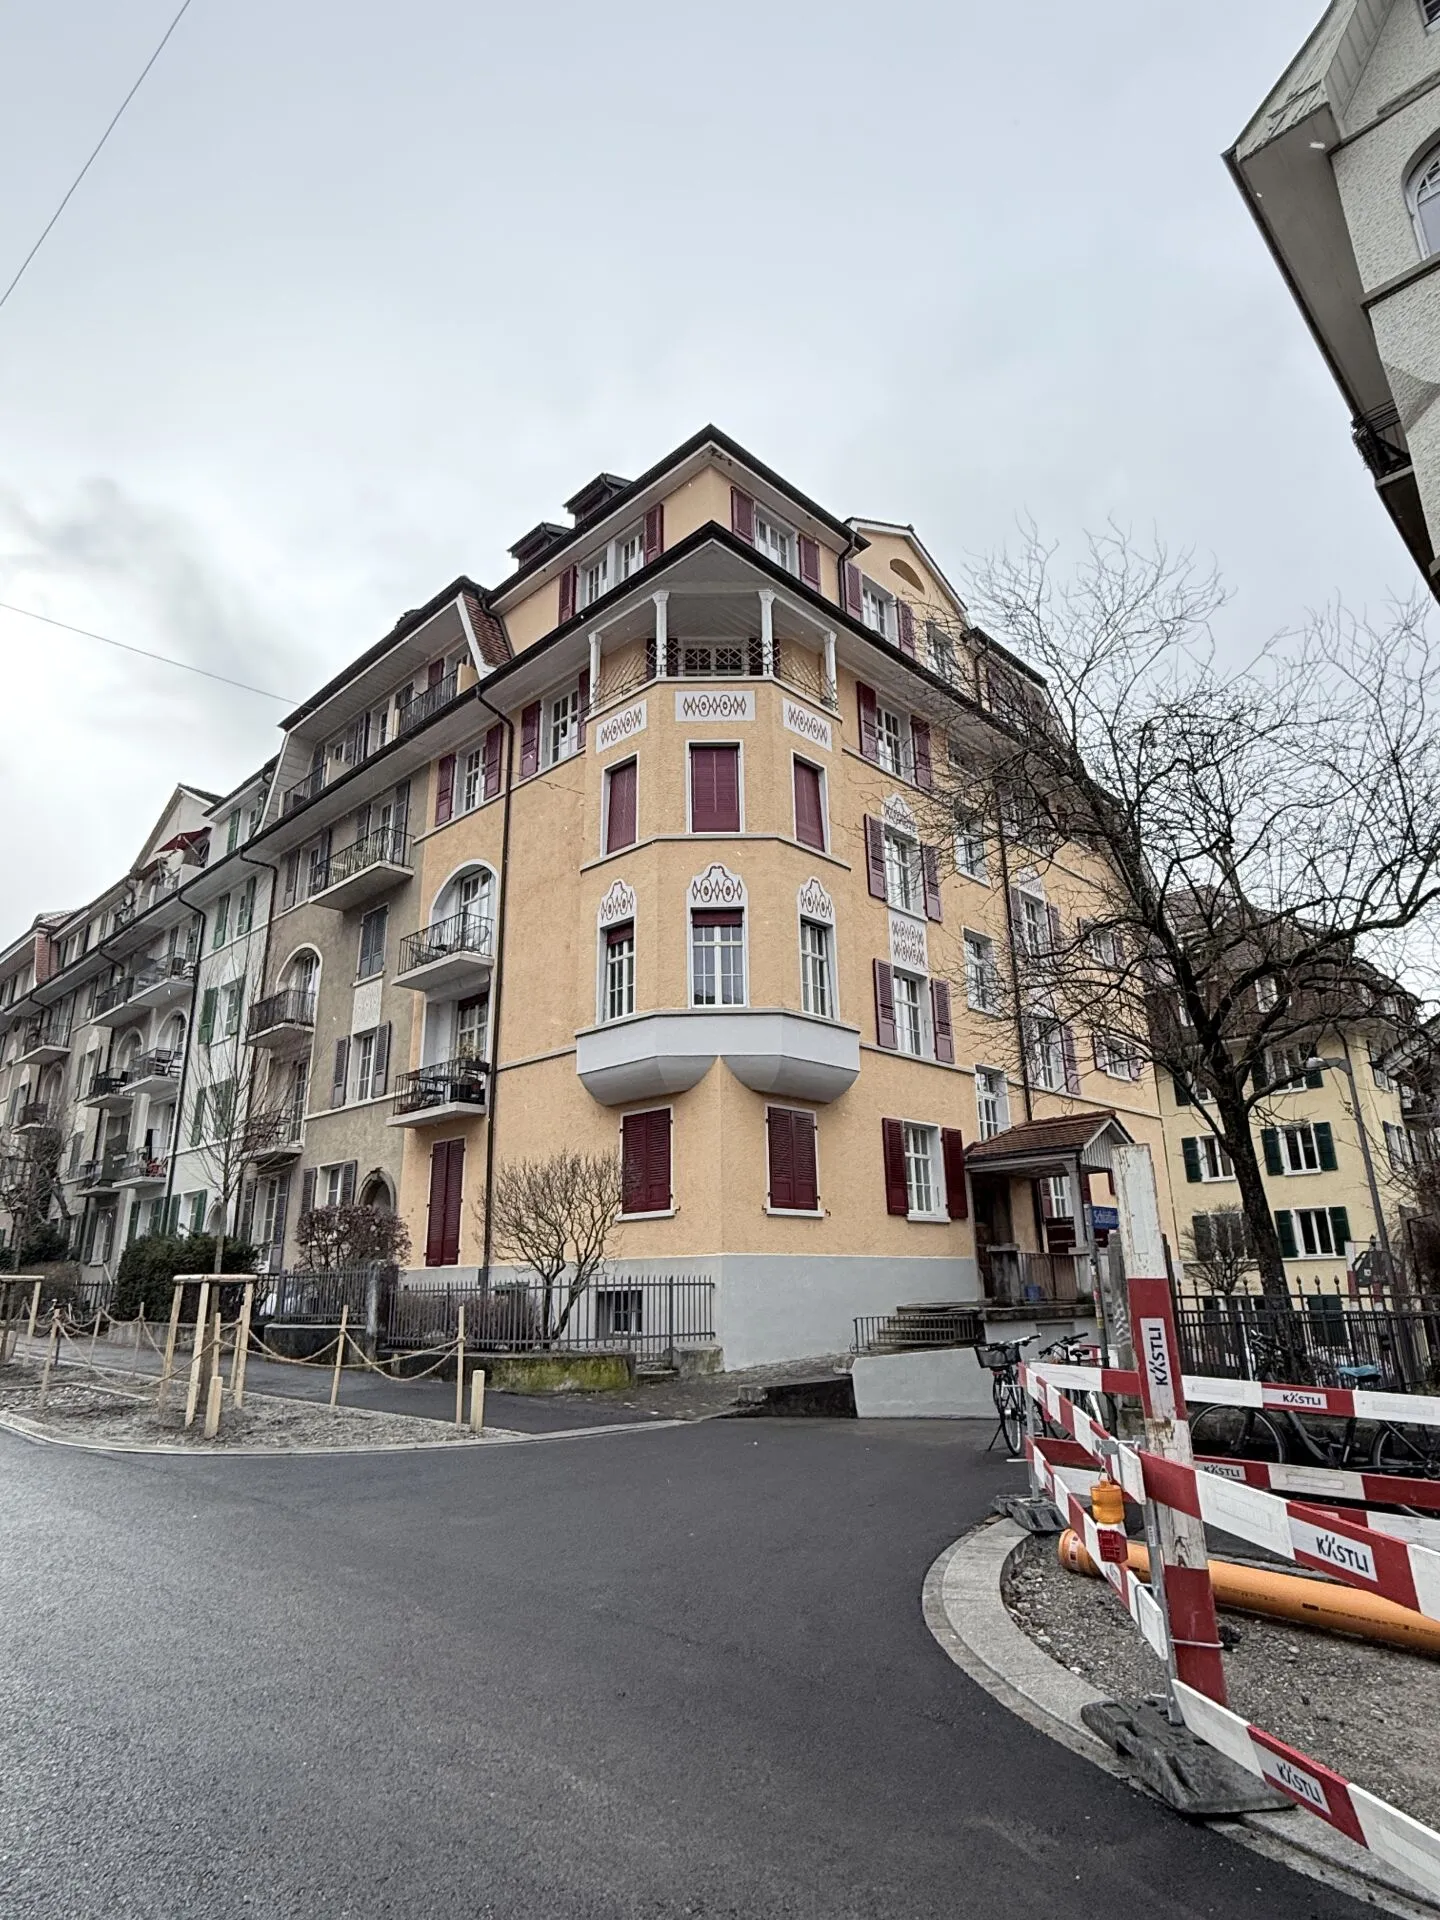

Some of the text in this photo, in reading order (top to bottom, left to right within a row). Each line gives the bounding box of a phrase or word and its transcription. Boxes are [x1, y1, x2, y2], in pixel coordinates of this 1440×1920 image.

[1148, 1327, 1168, 1386] KÄSTLI
[1282, 1392, 1322, 1406] KÄSTLI
[1316, 1534, 1370, 1574] KÄSTLI
[1276, 1762, 1323, 1805] KÄSTLI
